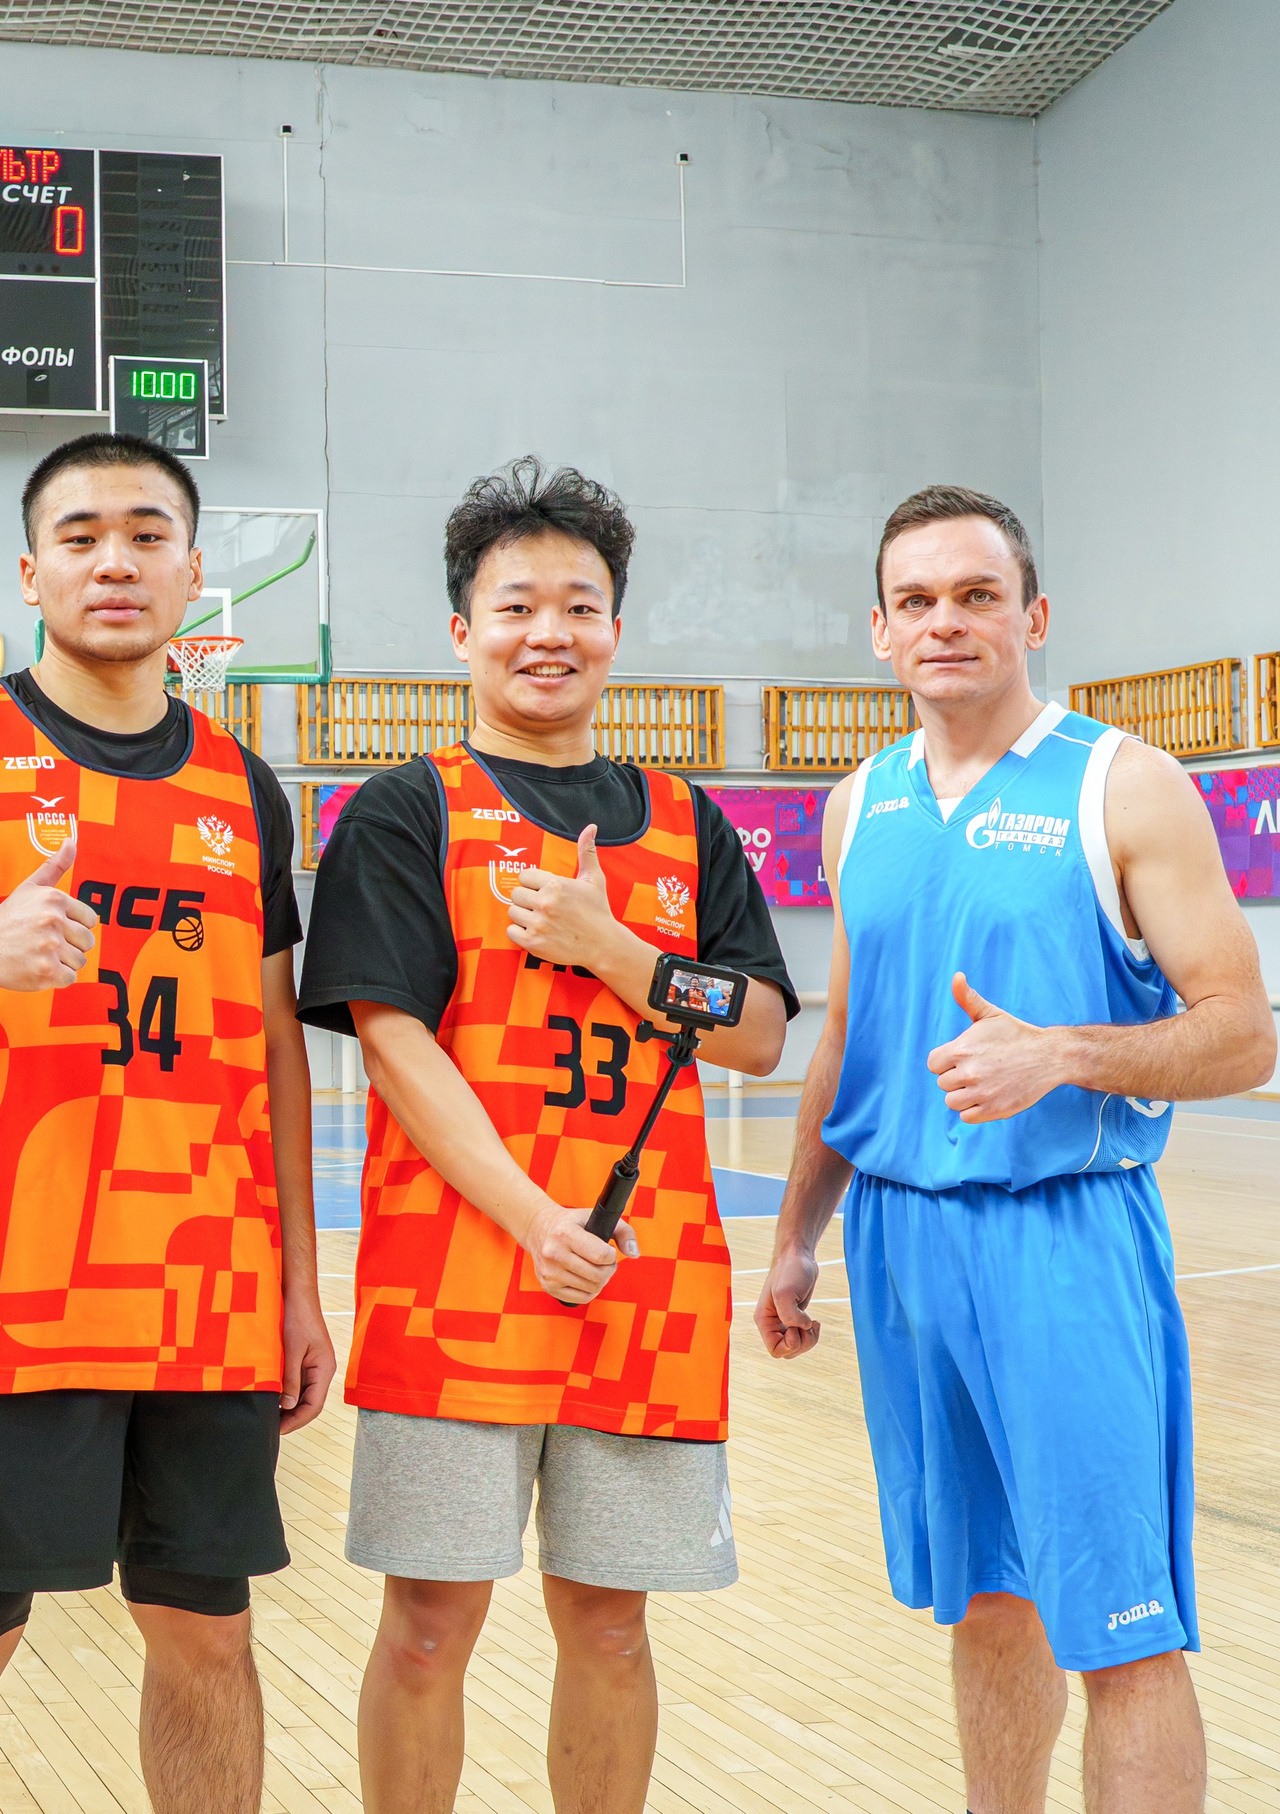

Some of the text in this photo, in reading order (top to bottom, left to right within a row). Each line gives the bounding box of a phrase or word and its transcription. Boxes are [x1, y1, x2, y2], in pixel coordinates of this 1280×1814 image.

[2, 184, 73, 205] СЧЕТ
[54, 205, 85, 256] 0
[1, 346, 75, 367] ФОЛЫ
[132, 371, 196, 400] 10.00
[4, 755, 56, 770] ZEDO
[472, 808, 521, 823] ZEDO
[998, 812, 1071, 837] ГАЗПРОМ
[995, 842, 1063, 857] ТОМСК
[999, 832, 1063, 847] ТРАНСГАЗ
[202, 855, 236, 869] МИНСПОРТ
[207, 864, 233, 877] РОССИИ
[78, 880, 206, 937] АСБ
[655, 915, 686, 931] МИНСПОРТ
[657, 925, 681, 938] РОССИИ
[97, 968, 182, 1072] 34
[544, 1014, 631, 1116] 33
[1107, 1599, 1165, 1631] Joma
